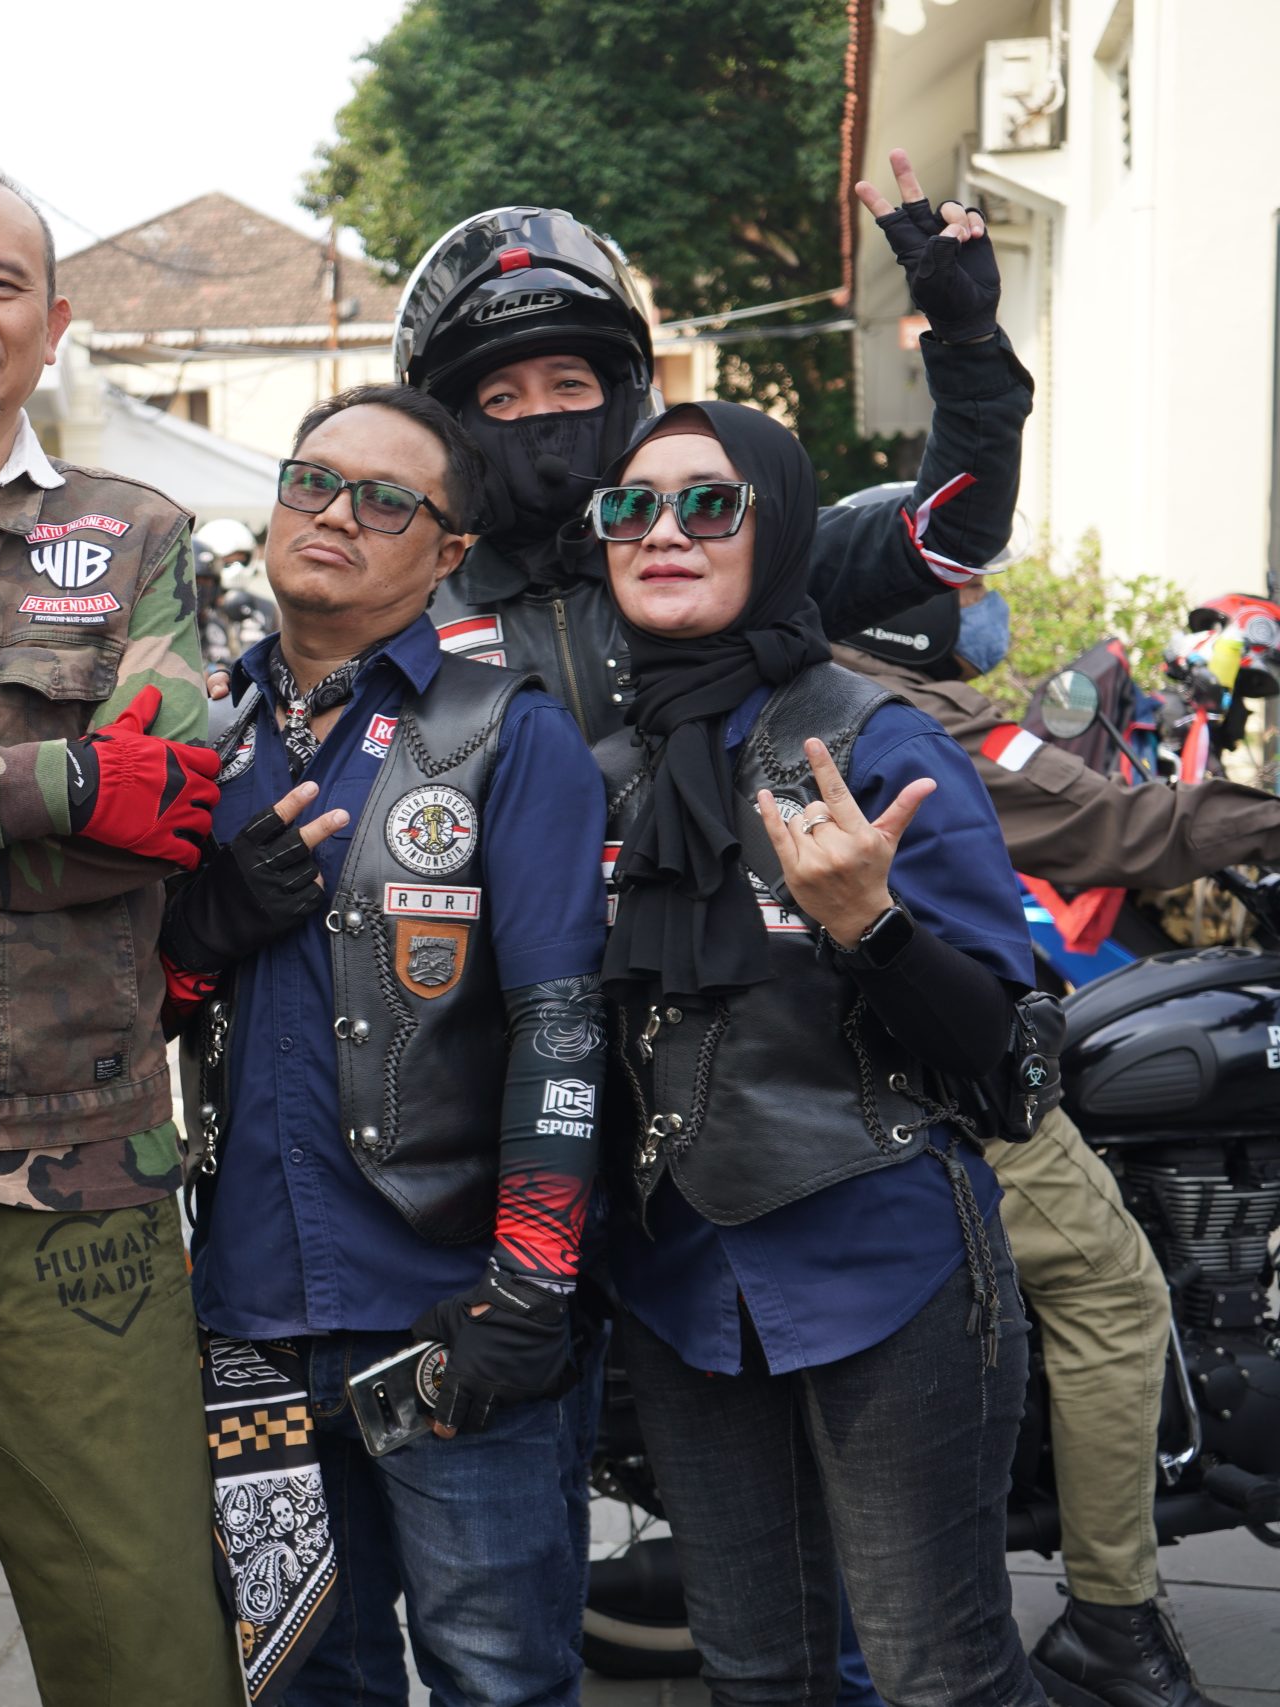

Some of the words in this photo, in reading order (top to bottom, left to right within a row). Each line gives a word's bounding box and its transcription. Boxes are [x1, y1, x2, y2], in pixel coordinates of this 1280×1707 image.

[481, 292, 556, 320] HJC
[29, 526, 63, 541] WAKTU
[67, 516, 121, 533] INDONESIA
[31, 540, 112, 588] WIB
[27, 597, 113, 612] BERKENDARA
[398, 796, 428, 822] ROYAL
[434, 793, 469, 821] RIDERS
[405, 846, 464, 867] INDONESIA
[398, 892, 470, 910] RORI
[536, 1119, 594, 1139] SPORT
[34, 1221, 160, 1281] HUMAN
[58, 1256, 155, 1307] MADE
